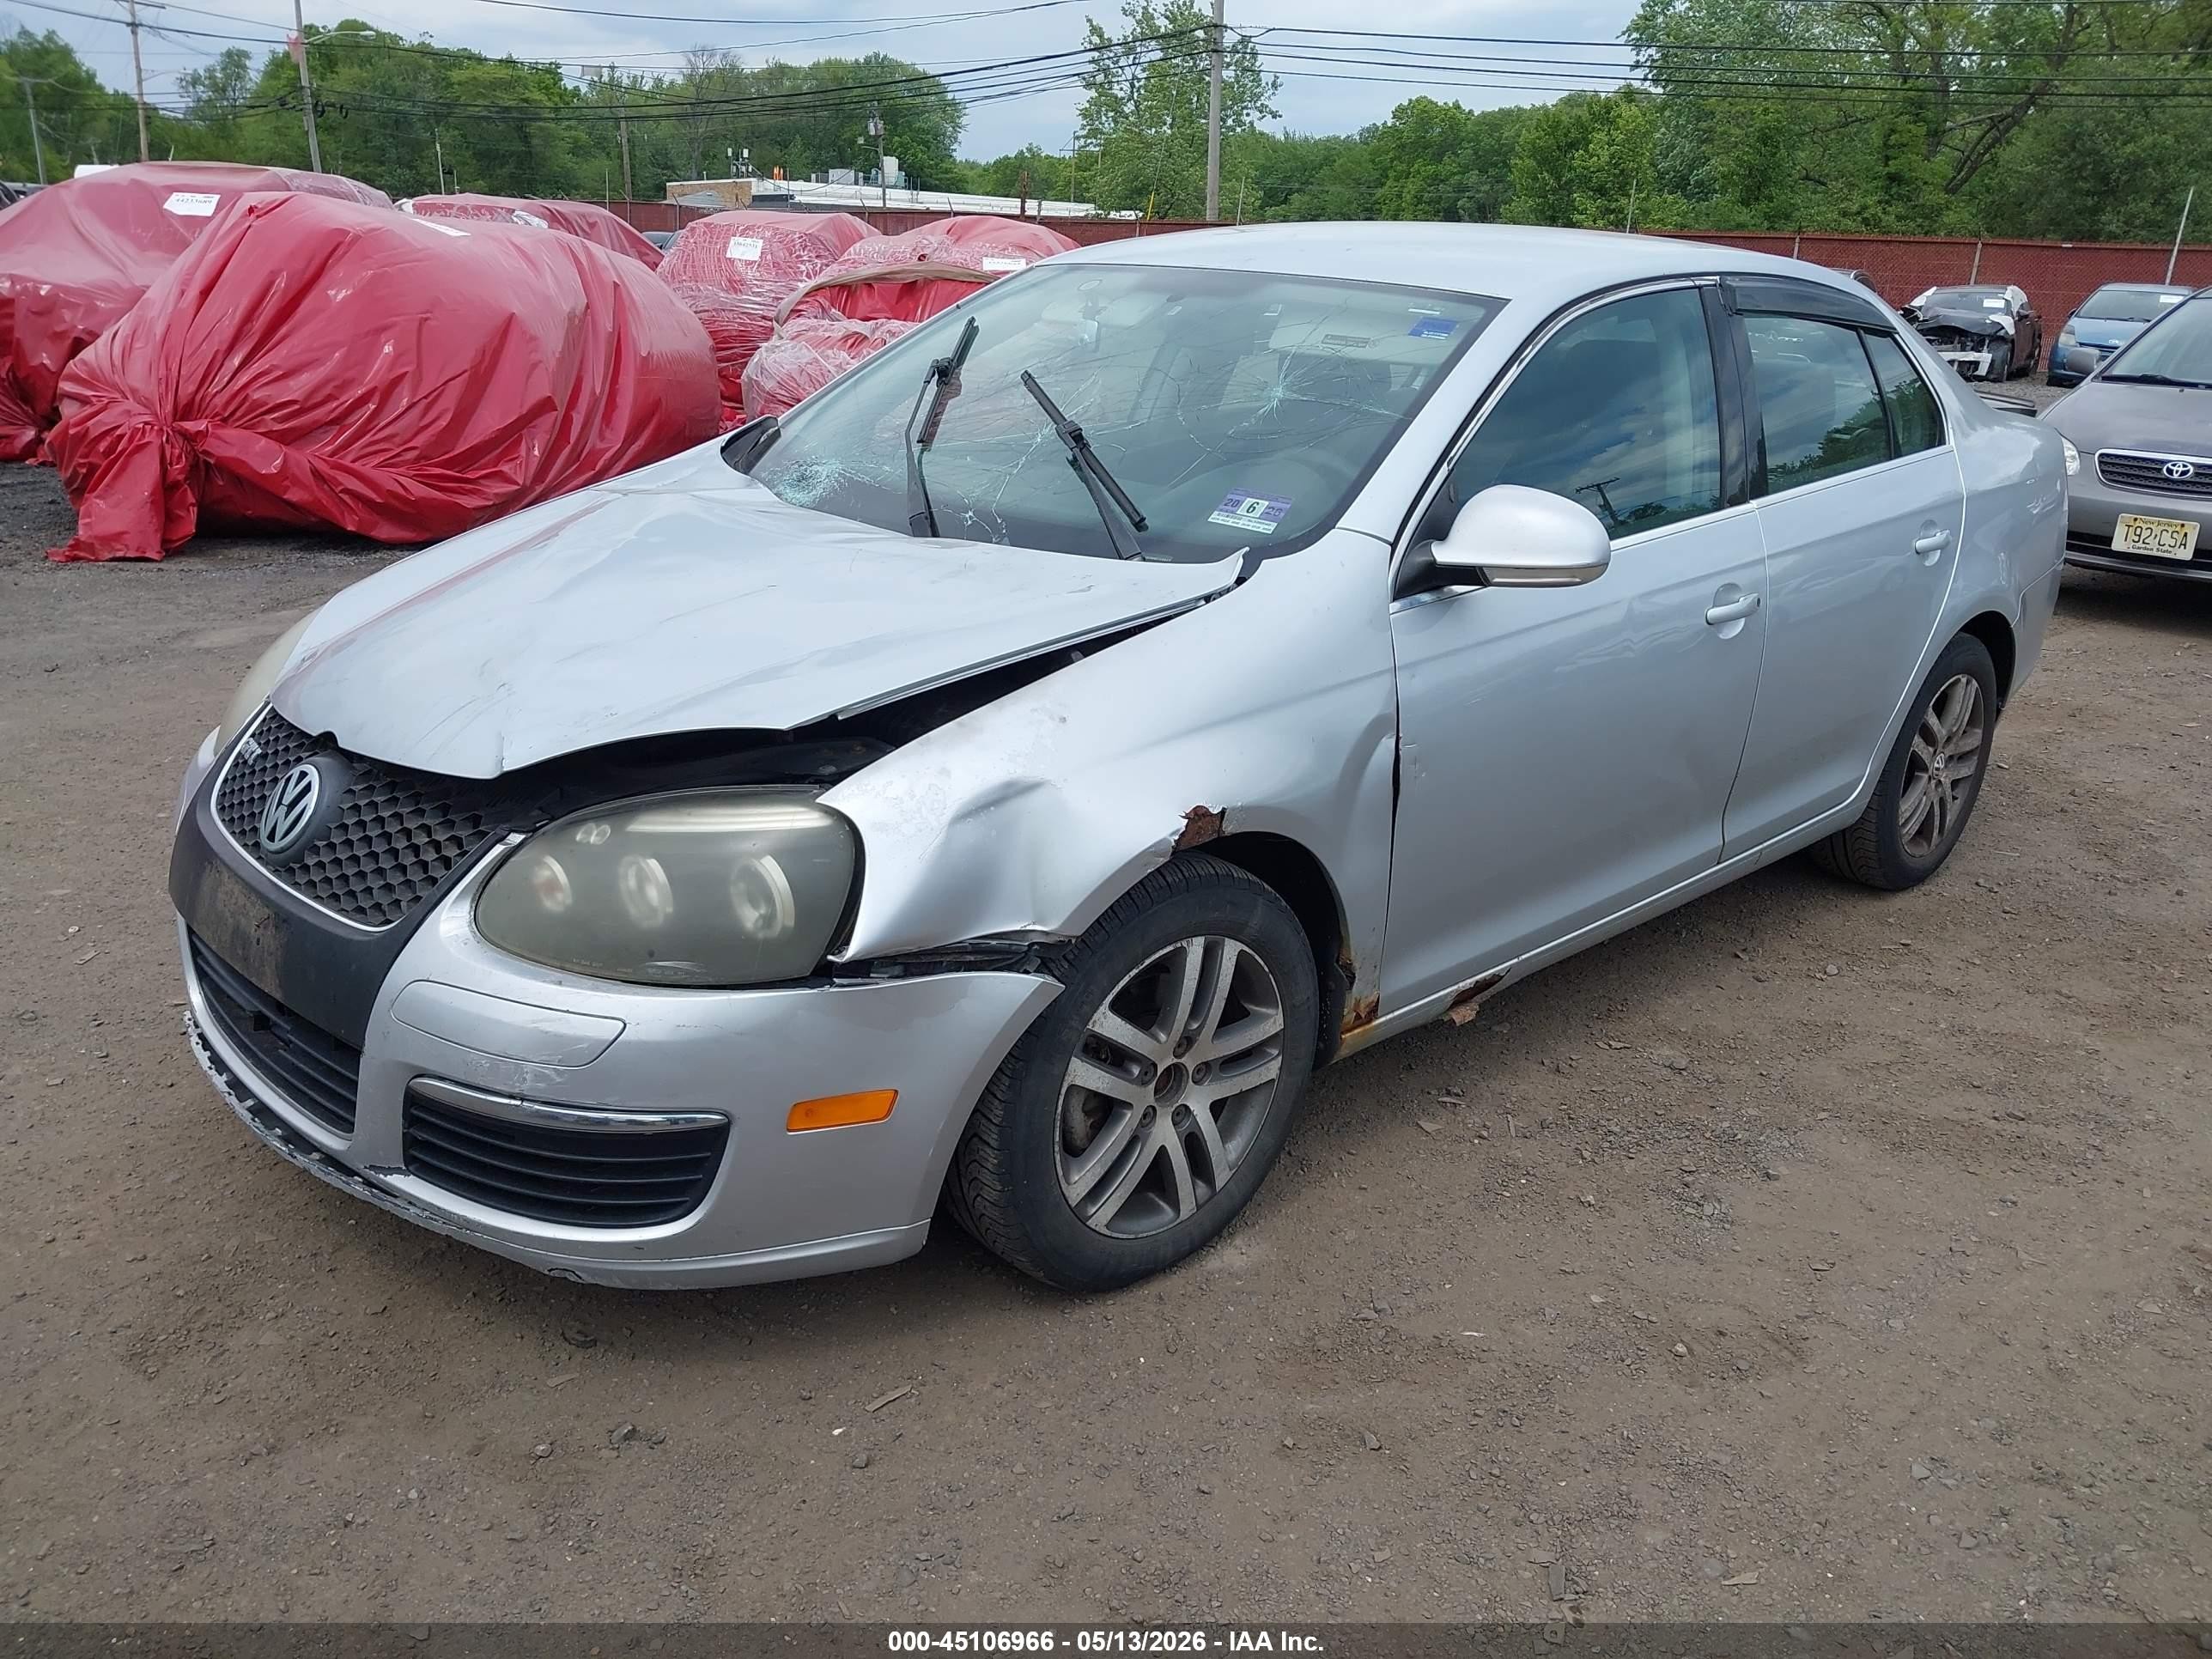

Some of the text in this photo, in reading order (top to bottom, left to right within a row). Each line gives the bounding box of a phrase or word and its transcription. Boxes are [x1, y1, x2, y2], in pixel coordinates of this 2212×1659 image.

[1224, 498, 1240, 508] 20
[1246, 501, 1260, 514] 6
[2156, 520, 2179, 529] Jersey
